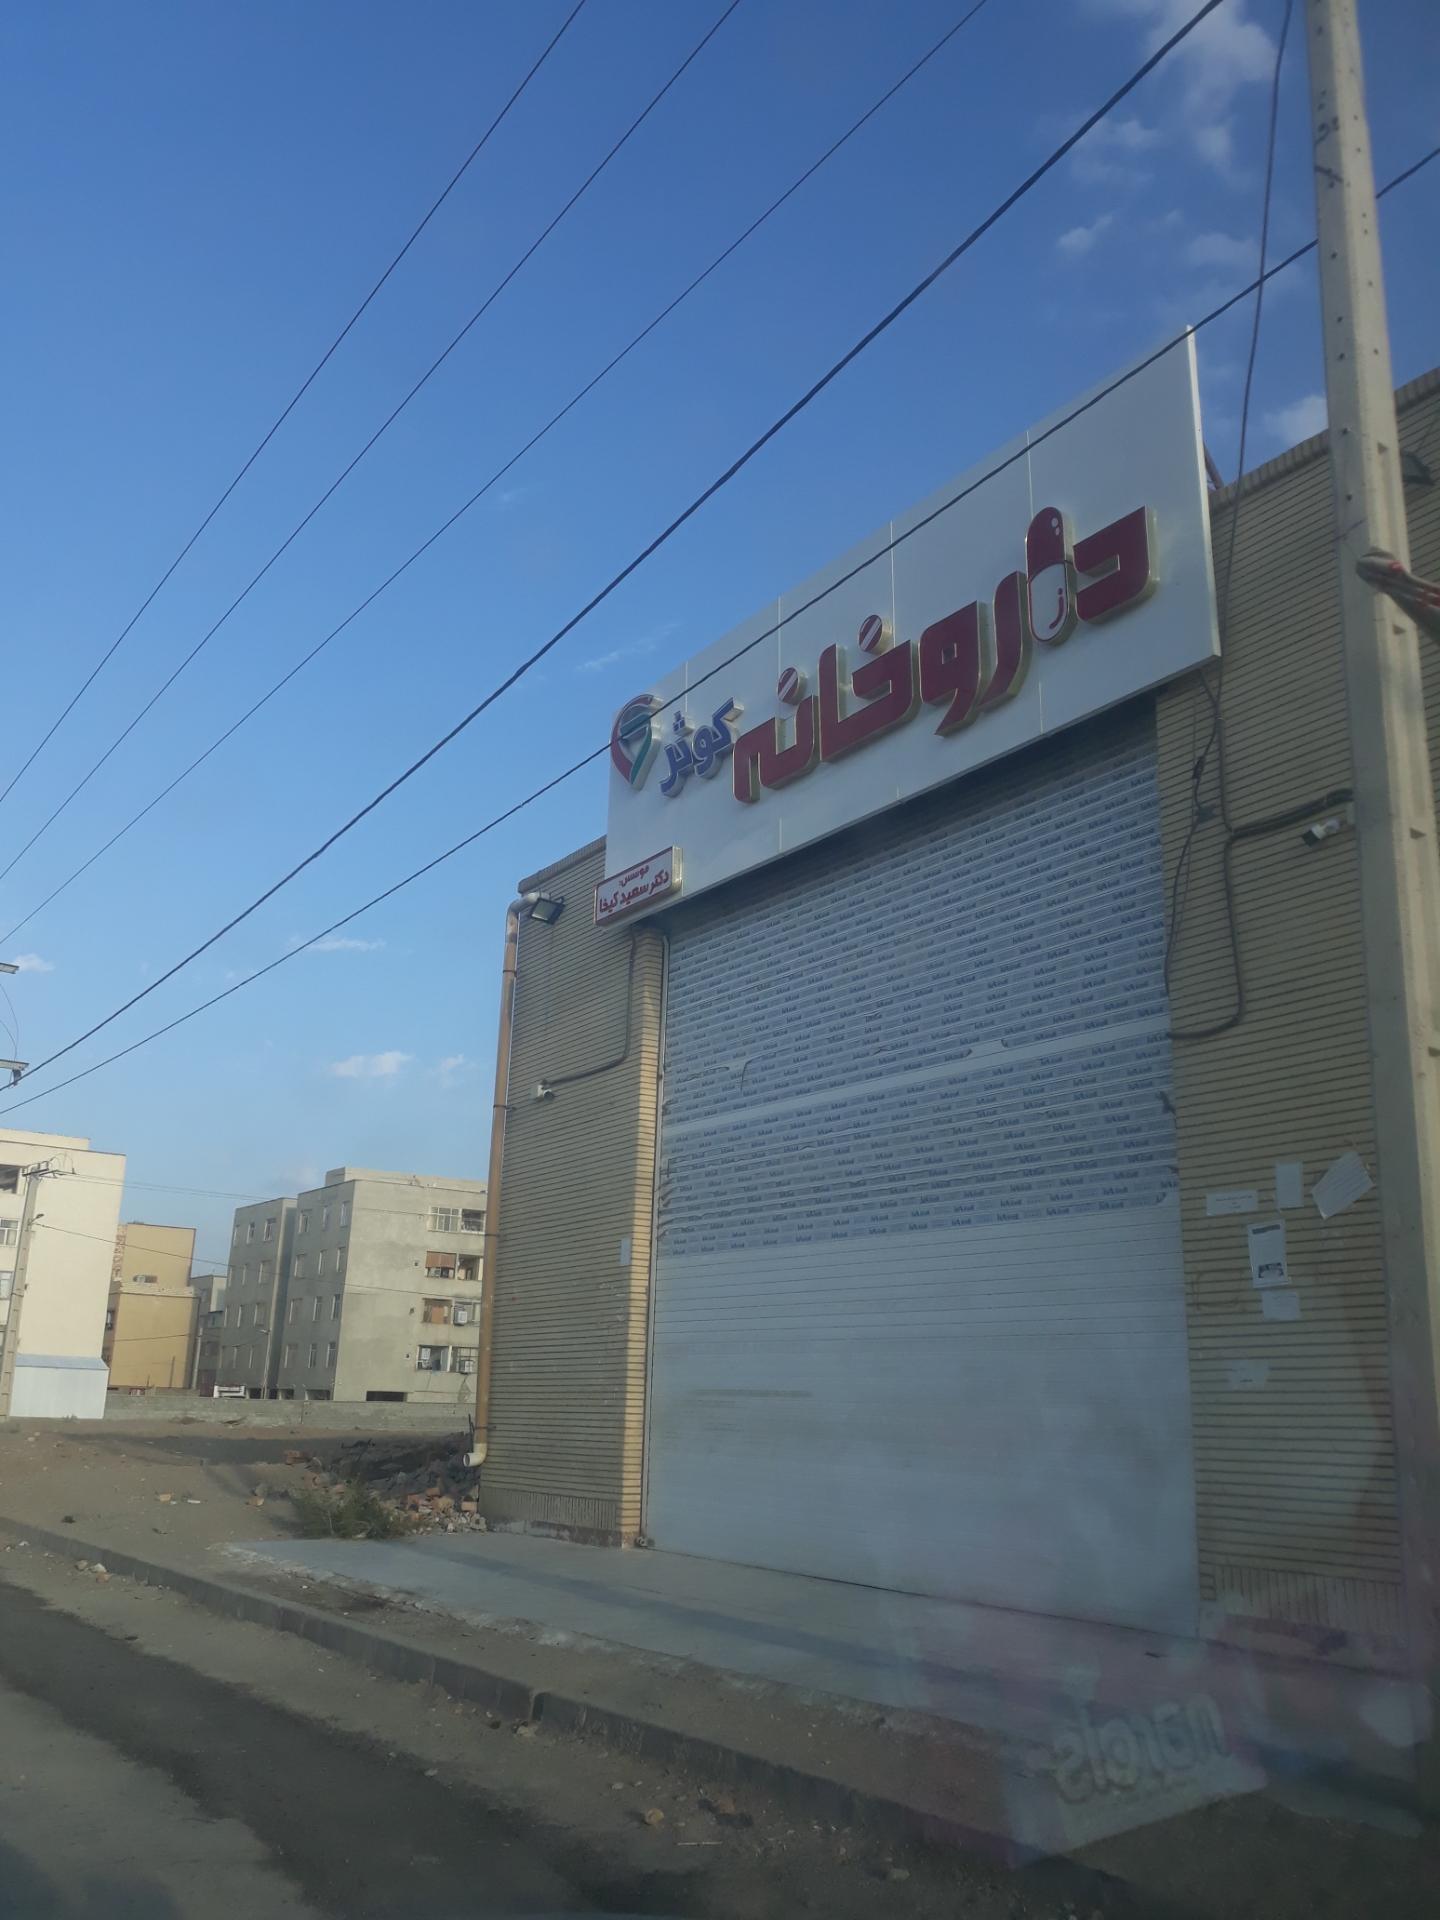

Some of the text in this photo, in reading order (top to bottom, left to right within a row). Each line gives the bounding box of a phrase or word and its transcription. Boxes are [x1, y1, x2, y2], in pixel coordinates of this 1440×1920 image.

[659, 505, 1152, 803] داروخانه کوثر
[620, 883, 649, 905] سعید
[649, 869, 669, 895] دکتر
